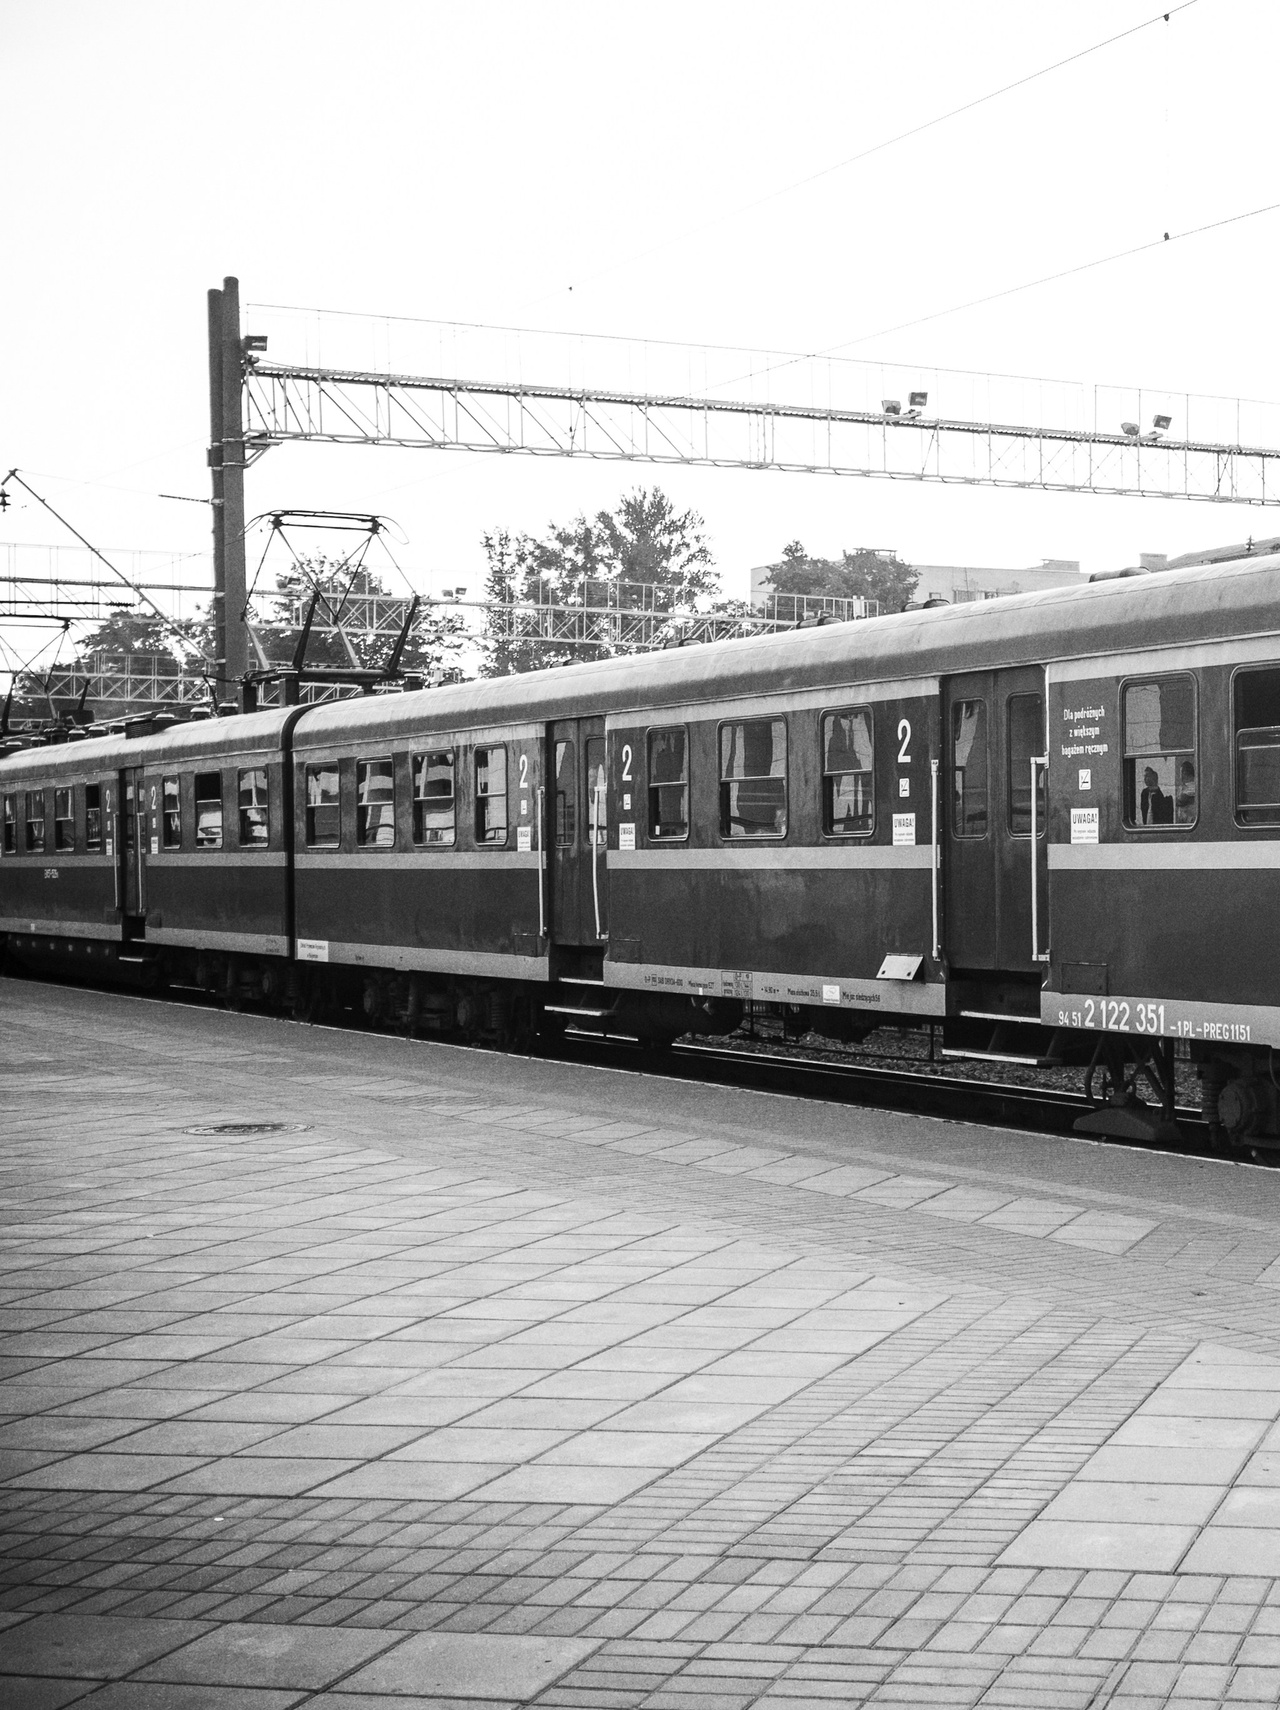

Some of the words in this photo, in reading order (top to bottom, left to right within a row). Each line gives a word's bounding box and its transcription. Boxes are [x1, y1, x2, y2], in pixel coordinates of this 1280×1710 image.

[1063, 709, 1074, 721] Dla
[897, 718, 912, 763] 2
[1069, 729, 1073, 738] z
[1073, 725, 1100, 738] większym
[622, 744, 632, 781] 2
[1061, 744, 1085, 758] bagażem
[1085, 743, 1108, 758] ręcznym
[519, 754, 528, 788] 2
[151, 785, 157, 810] 2
[1072, 813, 1098, 825] UWAGA!
[1058, 1011, 1069, 1026] 94
[1072, 1012, 1081, 1027] 51
[1084, 999, 1095, 1028] 2
[1100, 1000, 1130, 1031] 122
[1135, 1003, 1165, 1035] 351
